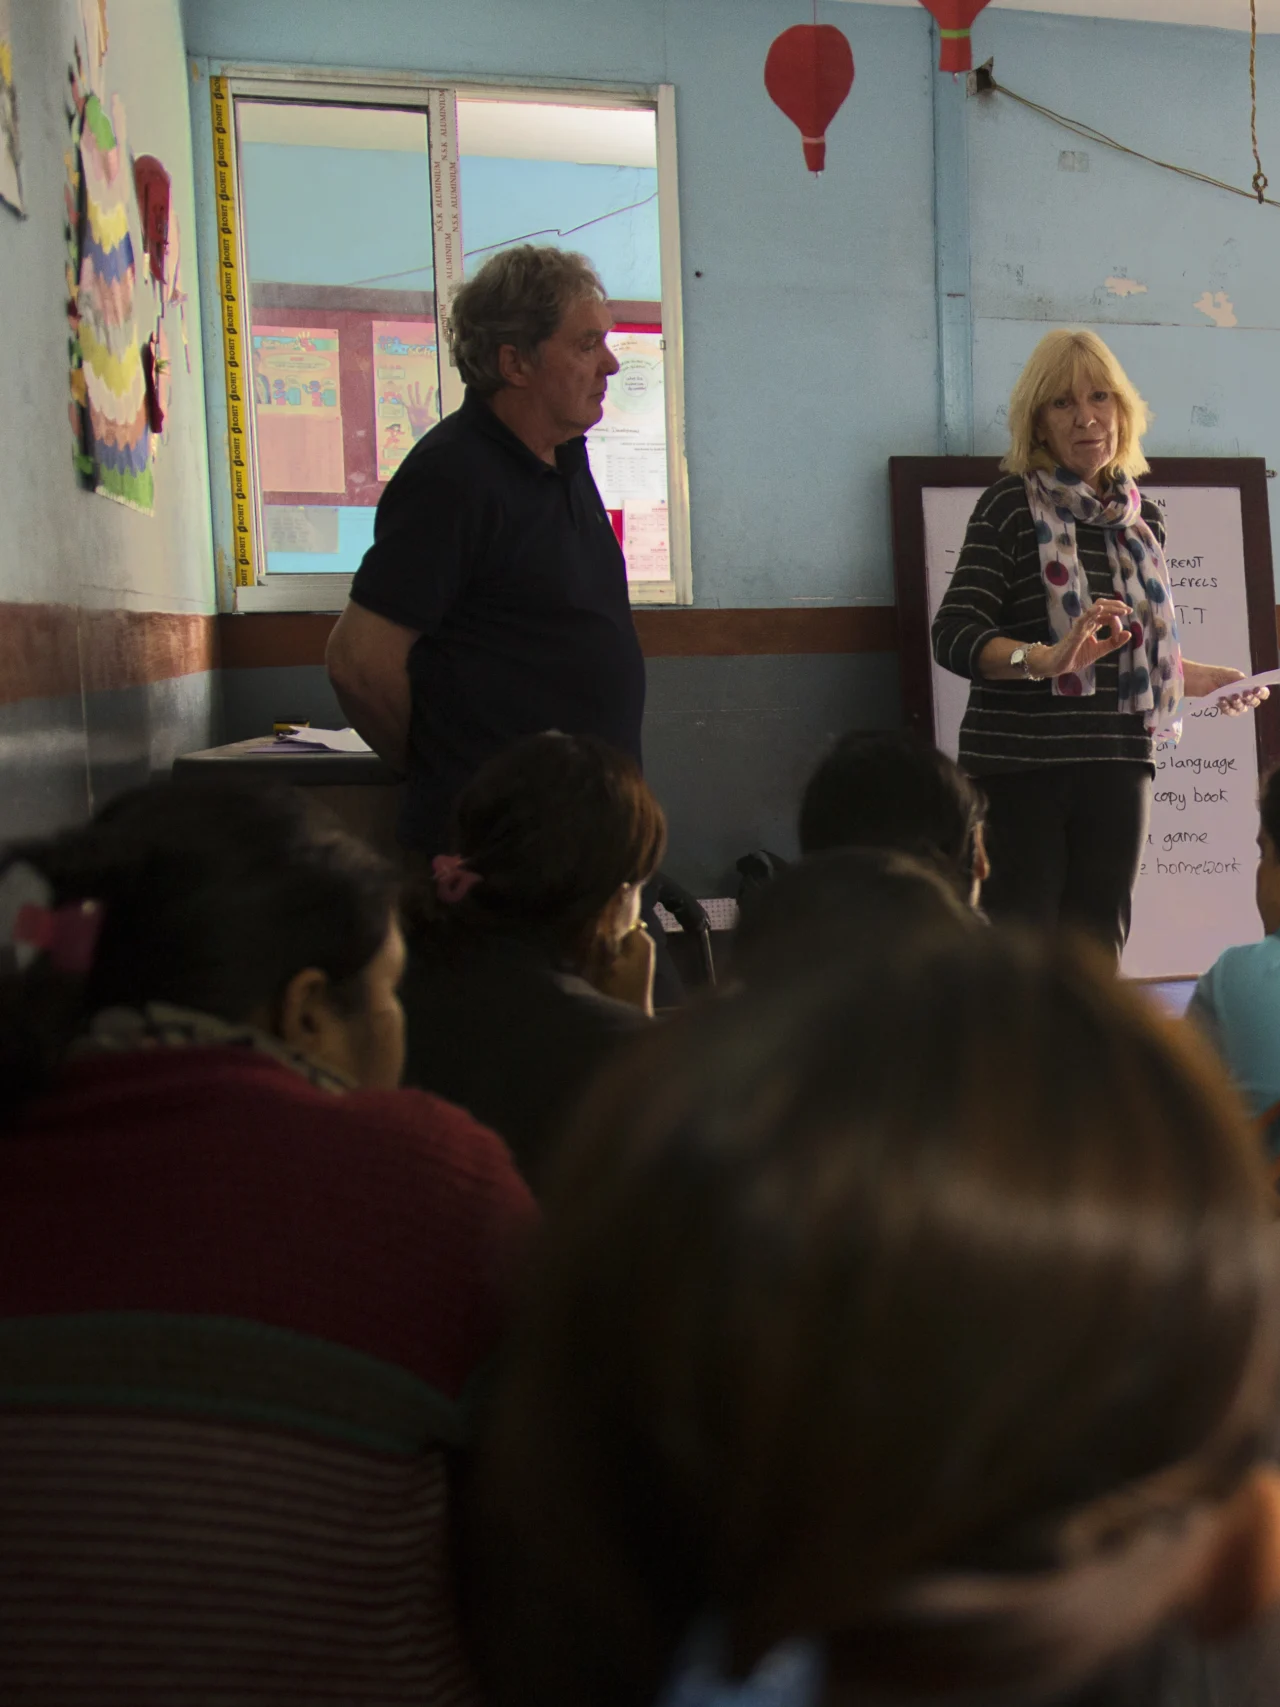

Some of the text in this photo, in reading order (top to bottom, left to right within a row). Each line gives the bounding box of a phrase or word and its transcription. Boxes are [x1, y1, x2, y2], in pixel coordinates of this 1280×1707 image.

[434, 162, 442, 208] ALUMINIUM
[450, 162, 458, 208] ALUMINIUM
[1166, 556, 1204, 568] RENT
[1170, 577, 1218, 588] LEVELS
[1170, 756, 1238, 775] language
[1154, 787, 1229, 811] copy book
[1162, 831, 1210, 852] game
[1156, 857, 1242, 875] homework
